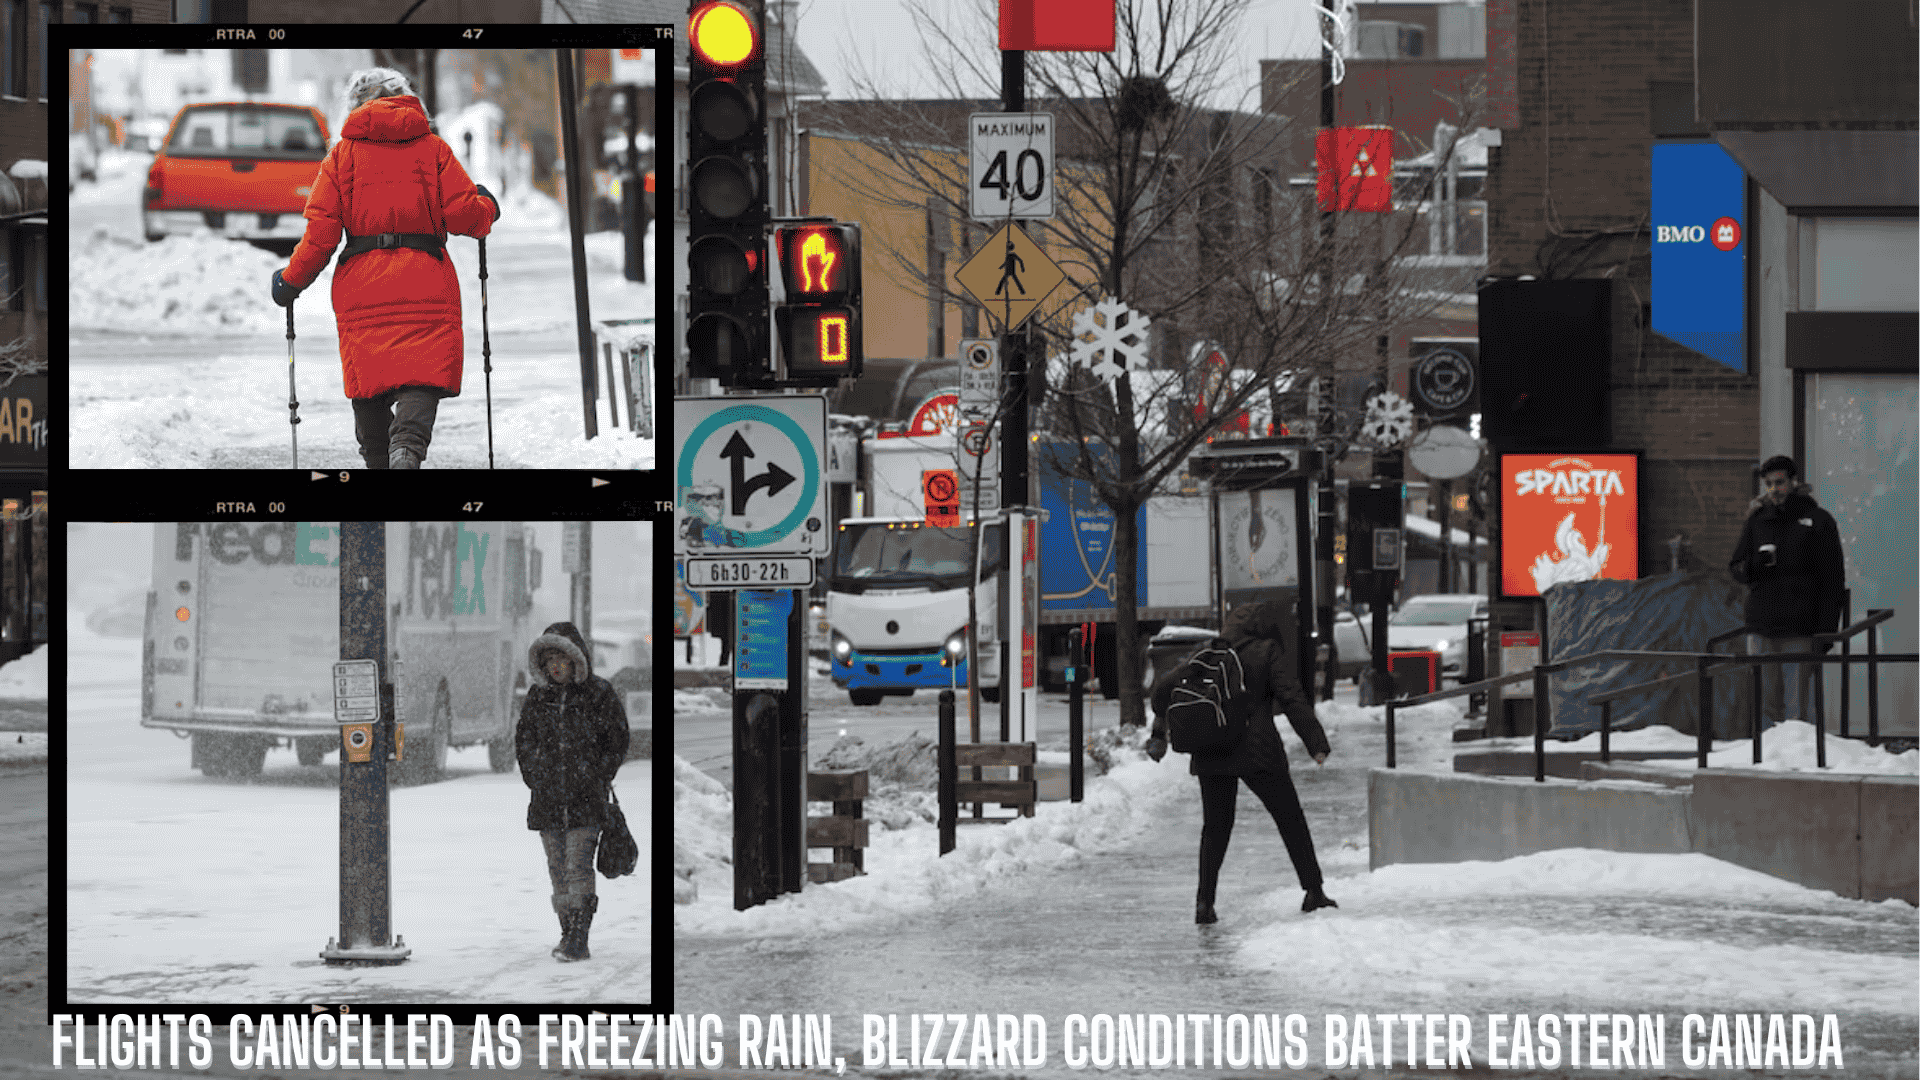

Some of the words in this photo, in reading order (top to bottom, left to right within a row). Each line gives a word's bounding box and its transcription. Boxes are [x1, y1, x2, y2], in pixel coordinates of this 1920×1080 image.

[978, 123, 1046, 136] MAXIMUM
[980, 149, 1044, 201] 40
[1657, 225, 1706, 243] BMO
[1515, 469, 1625, 497] SPARTA
[711, 563, 789, 581] 6h30-22h
